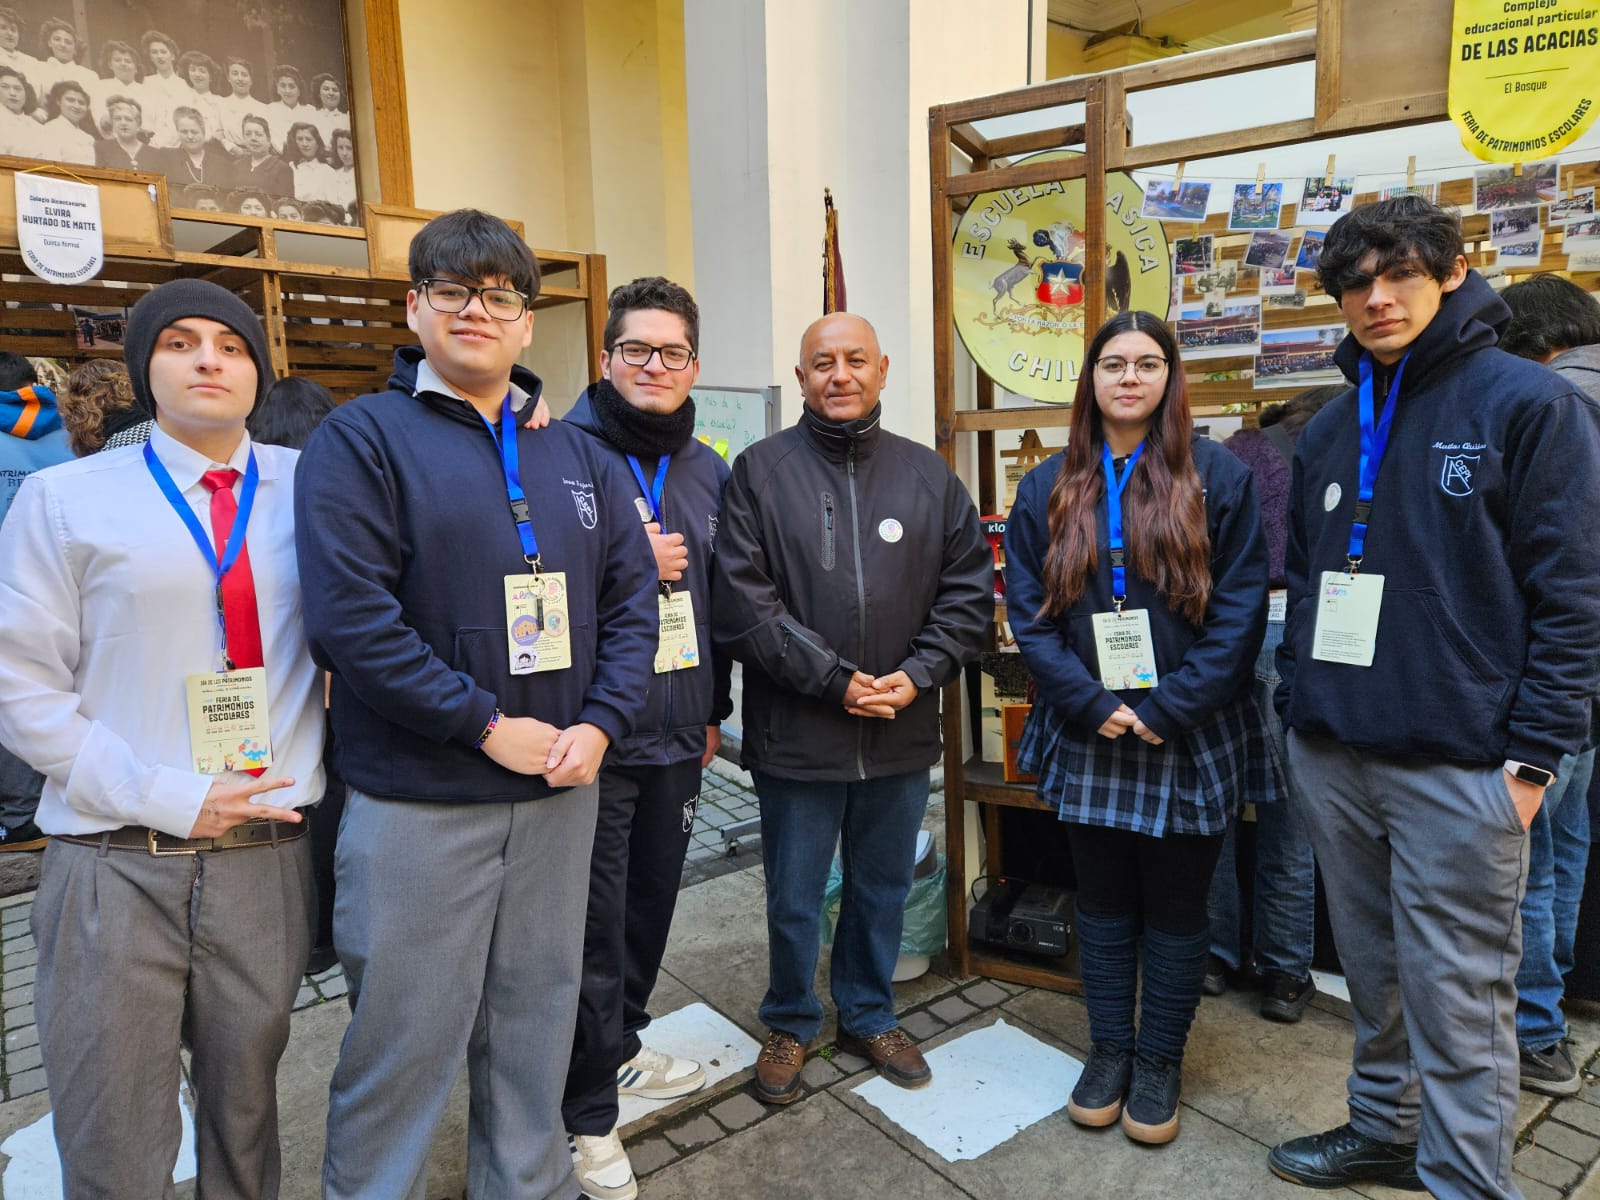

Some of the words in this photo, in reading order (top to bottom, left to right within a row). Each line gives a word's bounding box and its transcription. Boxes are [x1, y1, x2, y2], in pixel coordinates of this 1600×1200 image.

[1503, 0, 1557, 13] Complejo
[1465, 15, 1534, 35] educacional
[1537, 8, 1598, 26] particular
[1461, 43, 1482, 61] DE
[1487, 37, 1519, 59] LAS
[1524, 27, 1598, 53] ACACIAS
[1504, 83, 1512, 94] El
[1515, 80, 1548, 93] Bosque
[1461, 110, 1480, 134] FERIA
[1475, 130, 1489, 144] DE
[1487, 136, 1548, 153] PATRIMONIOS
[1549, 98, 1593, 143] ESCOLARES
[44, 206, 71, 218] ELVIRA
[22, 214, 59, 227] HURTADO
[60, 219, 71, 229] DE
[73, 220, 97, 231] MATTE
[962, 181, 1065, 260] ESCUELA
[1106, 191, 1160, 274] ASICA
[1008, 349, 1080, 382] CHIL
[202, 700, 255, 714] PATRIMONIOS
[208, 710, 250, 722] ESCOLARES
